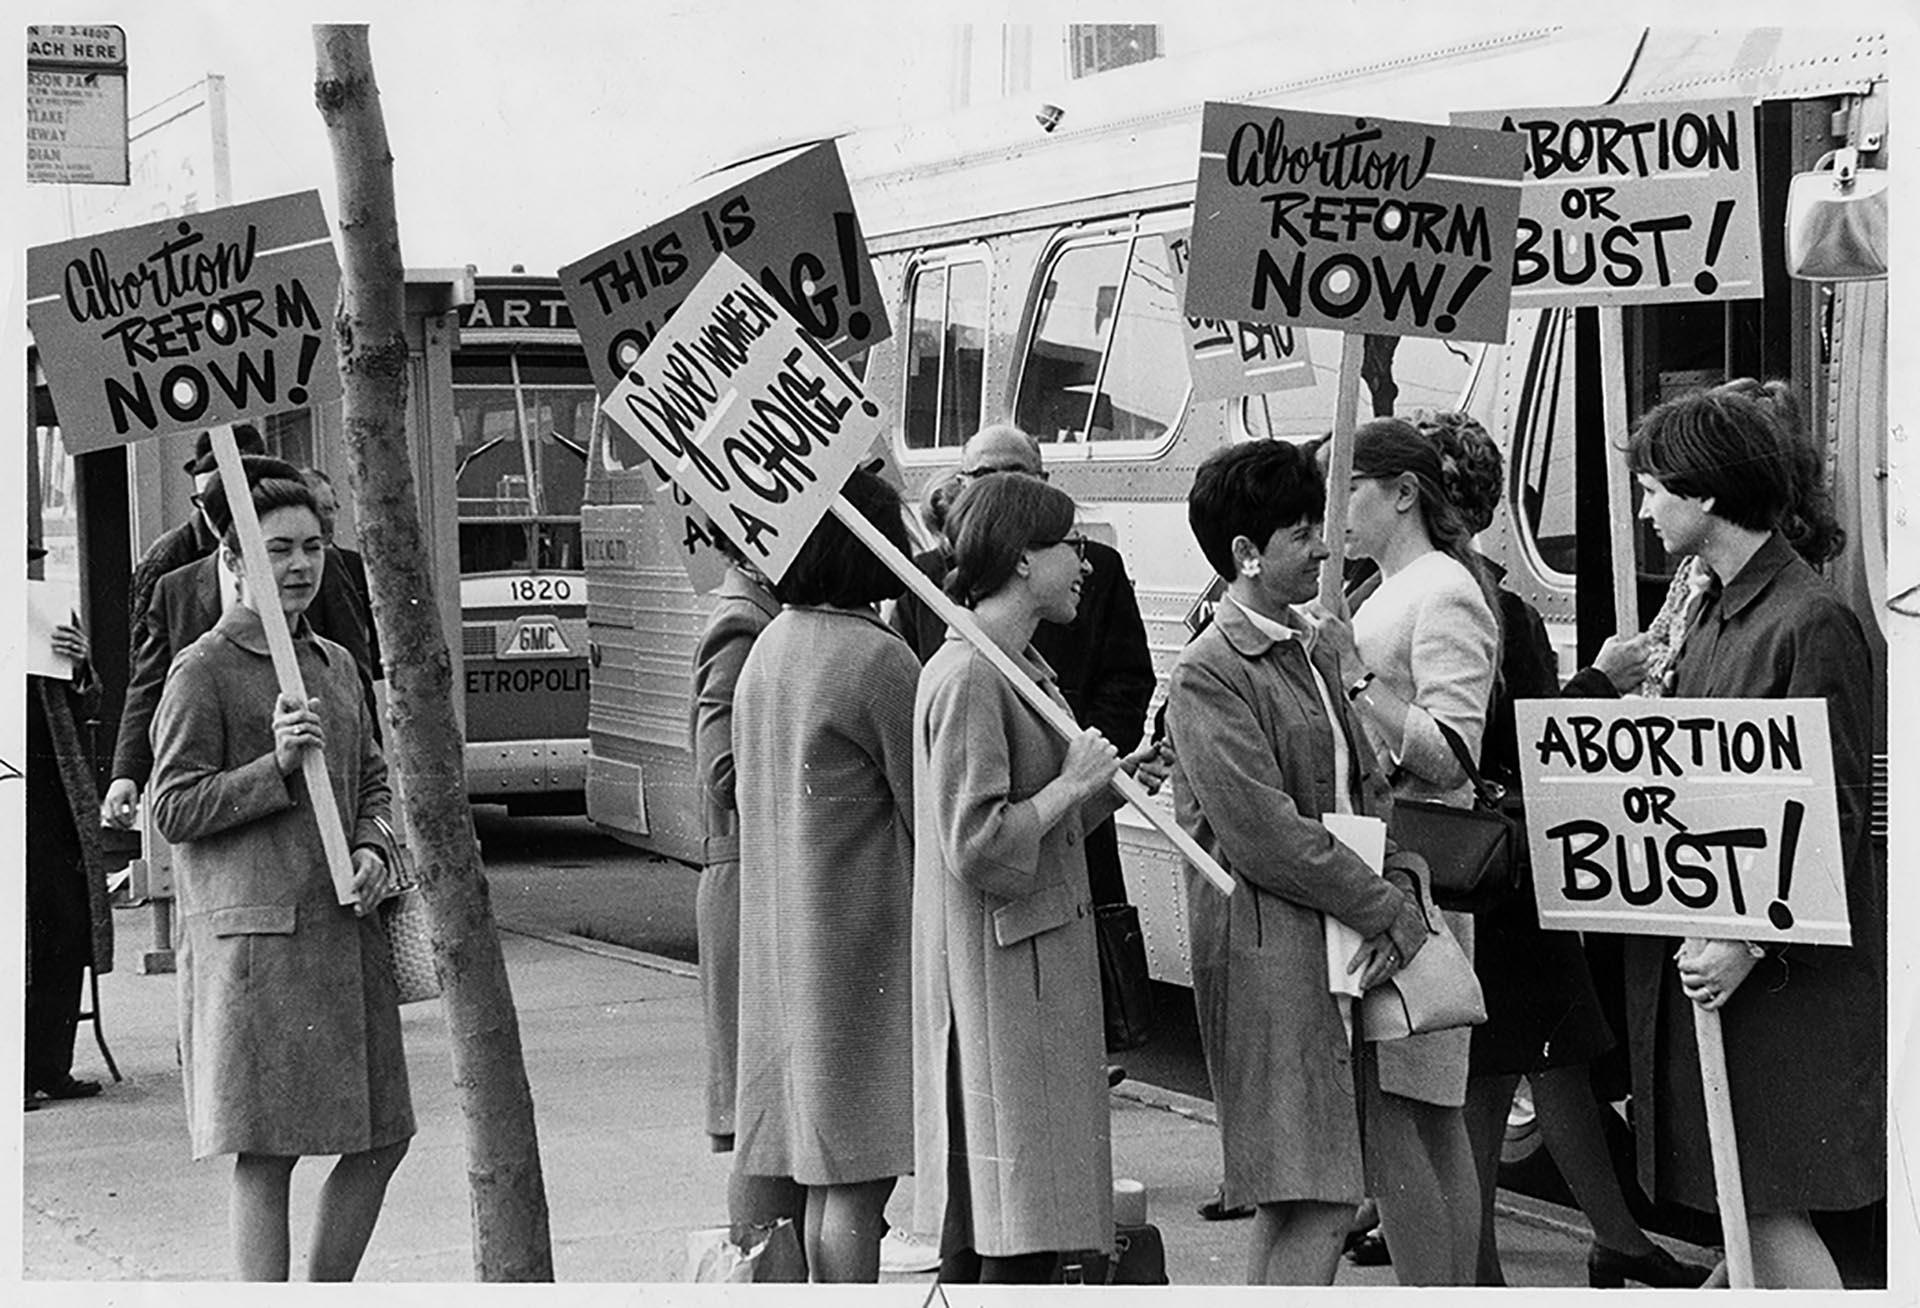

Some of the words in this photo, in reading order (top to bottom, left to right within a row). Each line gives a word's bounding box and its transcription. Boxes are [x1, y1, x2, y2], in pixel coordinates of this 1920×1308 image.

[73, 43, 117, 58] HERE
[1226, 116, 1436, 192] Abortion
[1260, 191, 1493, 263] REFORM
[1560, 186, 1622, 222] OR
[65, 221, 256, 322] Abortion
[580, 231, 688, 316] THIS
[702, 195, 756, 254] IS
[1511, 199, 1737, 296] BUST!
[102, 279, 322, 367] REFORM
[1250, 248, 1494, 334] NOW!
[104, 335, 321, 434] NOW!
[625, 341, 730, 492] Give
[690, 282, 778, 378] WOMEN
[724, 326, 879, 504] CHOICE!
[729, 502, 779, 557] A
[510, 578, 571, 601] 1820
[519, 626, 556, 651] GMC
[1535, 714, 1803, 777] ABORTION
[1622, 785, 1688, 833] OR
[1545, 799, 1806, 931] BUST!
